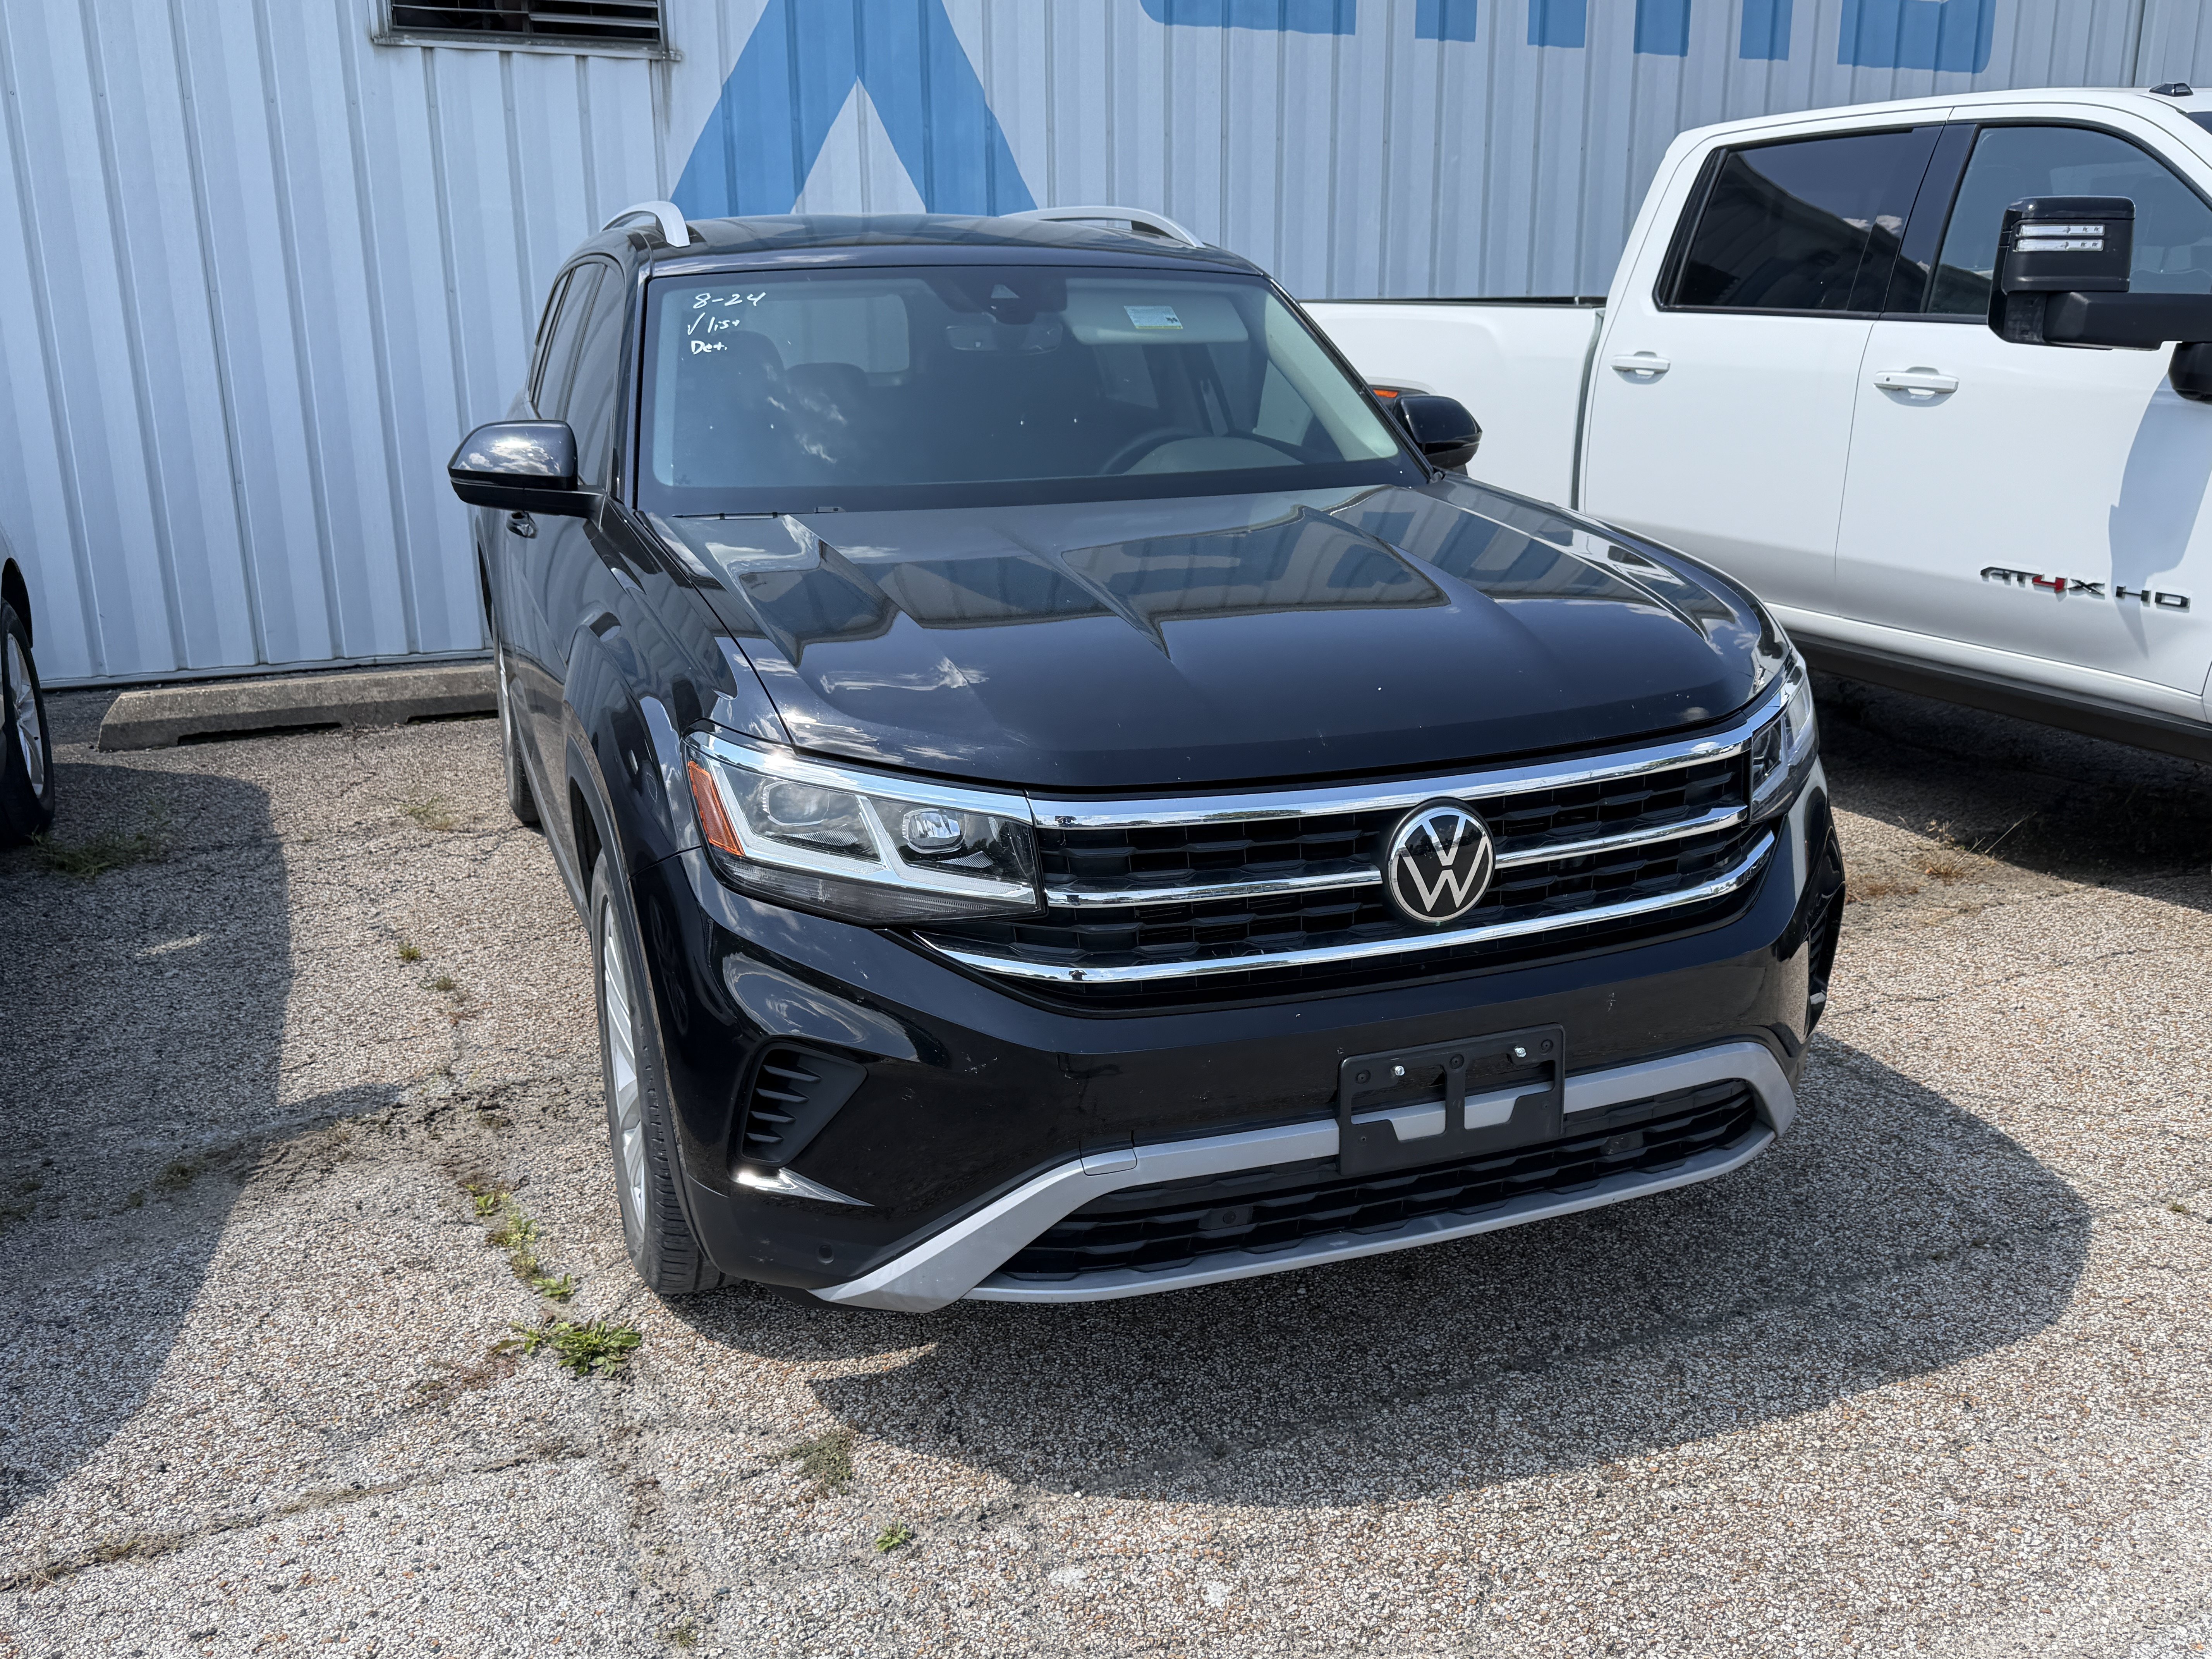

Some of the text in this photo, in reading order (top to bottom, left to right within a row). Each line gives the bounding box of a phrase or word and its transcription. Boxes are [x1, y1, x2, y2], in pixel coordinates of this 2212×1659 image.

[693, 292, 766, 309] 8-24
[2116, 585, 2190, 608] HD
[1395, 810, 1490, 916] VW
